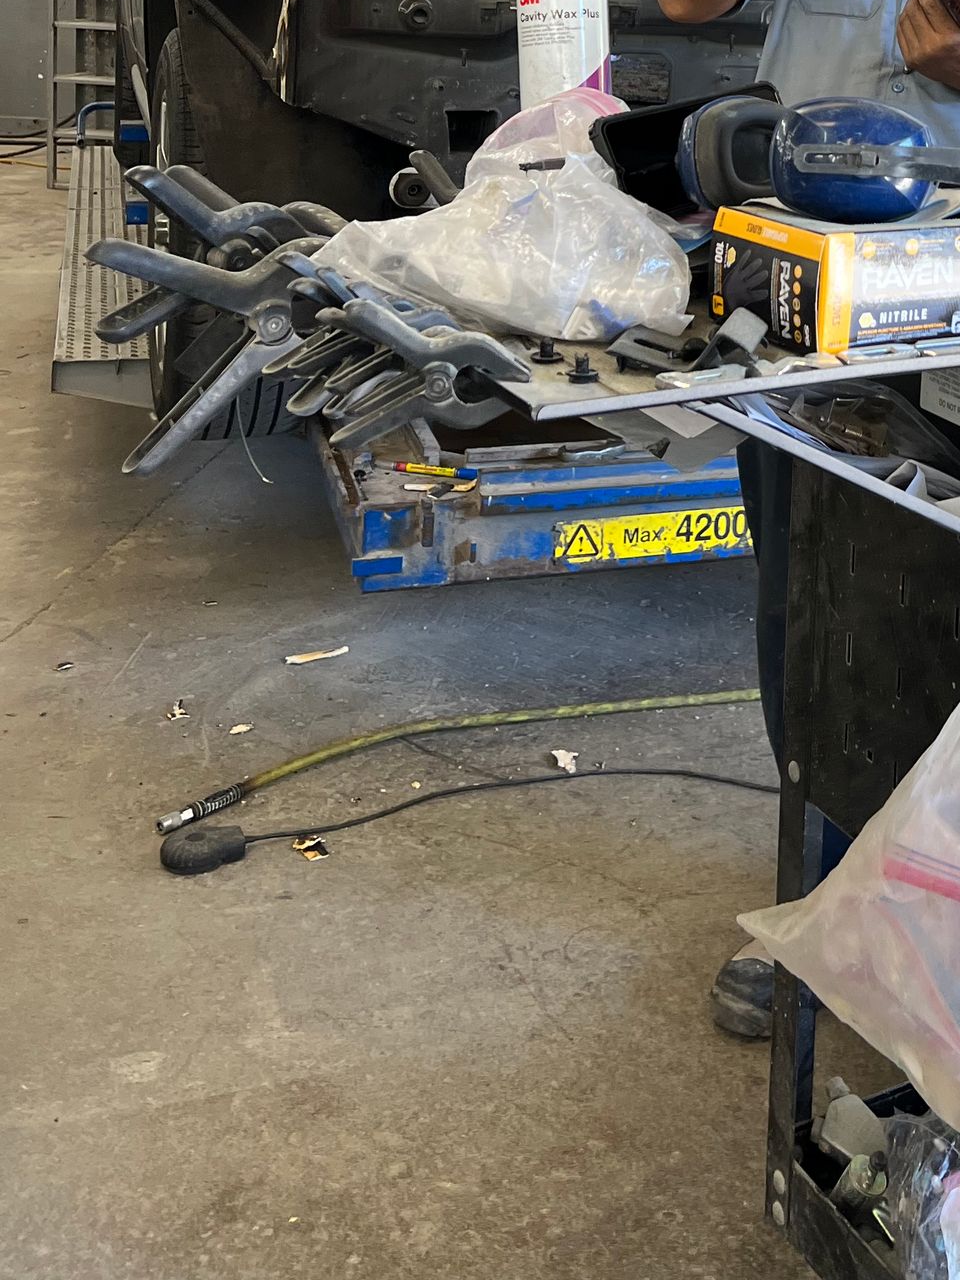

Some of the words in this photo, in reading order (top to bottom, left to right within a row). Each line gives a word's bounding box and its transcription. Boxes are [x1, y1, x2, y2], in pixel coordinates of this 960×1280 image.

[520, 10, 548, 23] Cavity
[551, 9, 577, 20] Wax
[581, 8, 600, 19] Plus
[714, 241, 724, 263] 100
[860, 256, 954, 295] RAVEN
[778, 260, 792, 340] RAVEN
[879, 308, 928, 324] NITRILE
[946, 401, 957, 412] NOT
[623, 527, 668, 544] Max.
[676, 509, 748, 543] 4200
